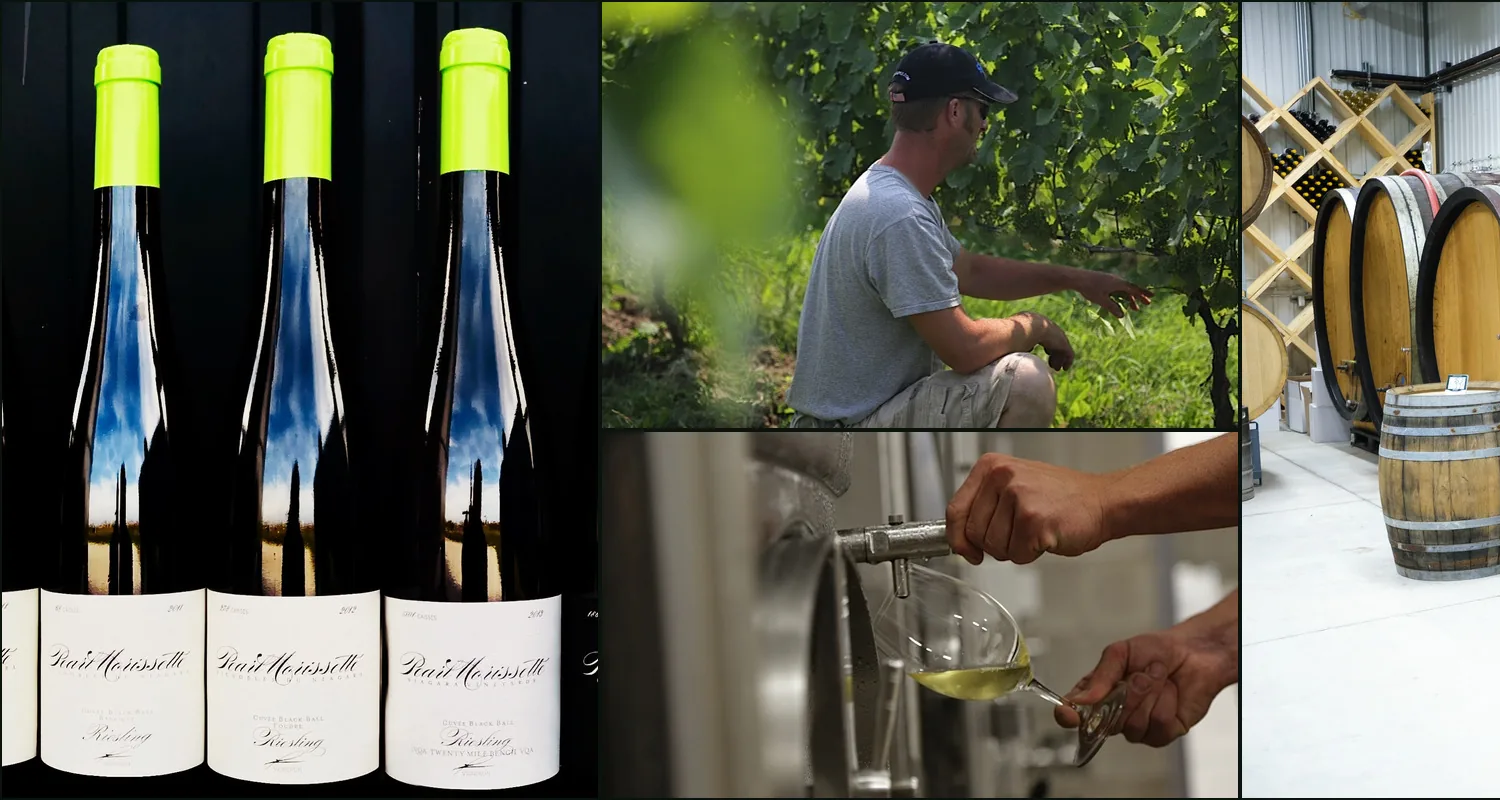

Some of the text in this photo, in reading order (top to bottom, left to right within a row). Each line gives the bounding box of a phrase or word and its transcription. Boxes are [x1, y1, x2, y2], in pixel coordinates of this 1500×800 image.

[257, 651, 365, 686] Morissette
[445, 655, 549, 691] Morissette
[252, 726, 326, 757] Riesling
[439, 726, 515, 755] Riesling
